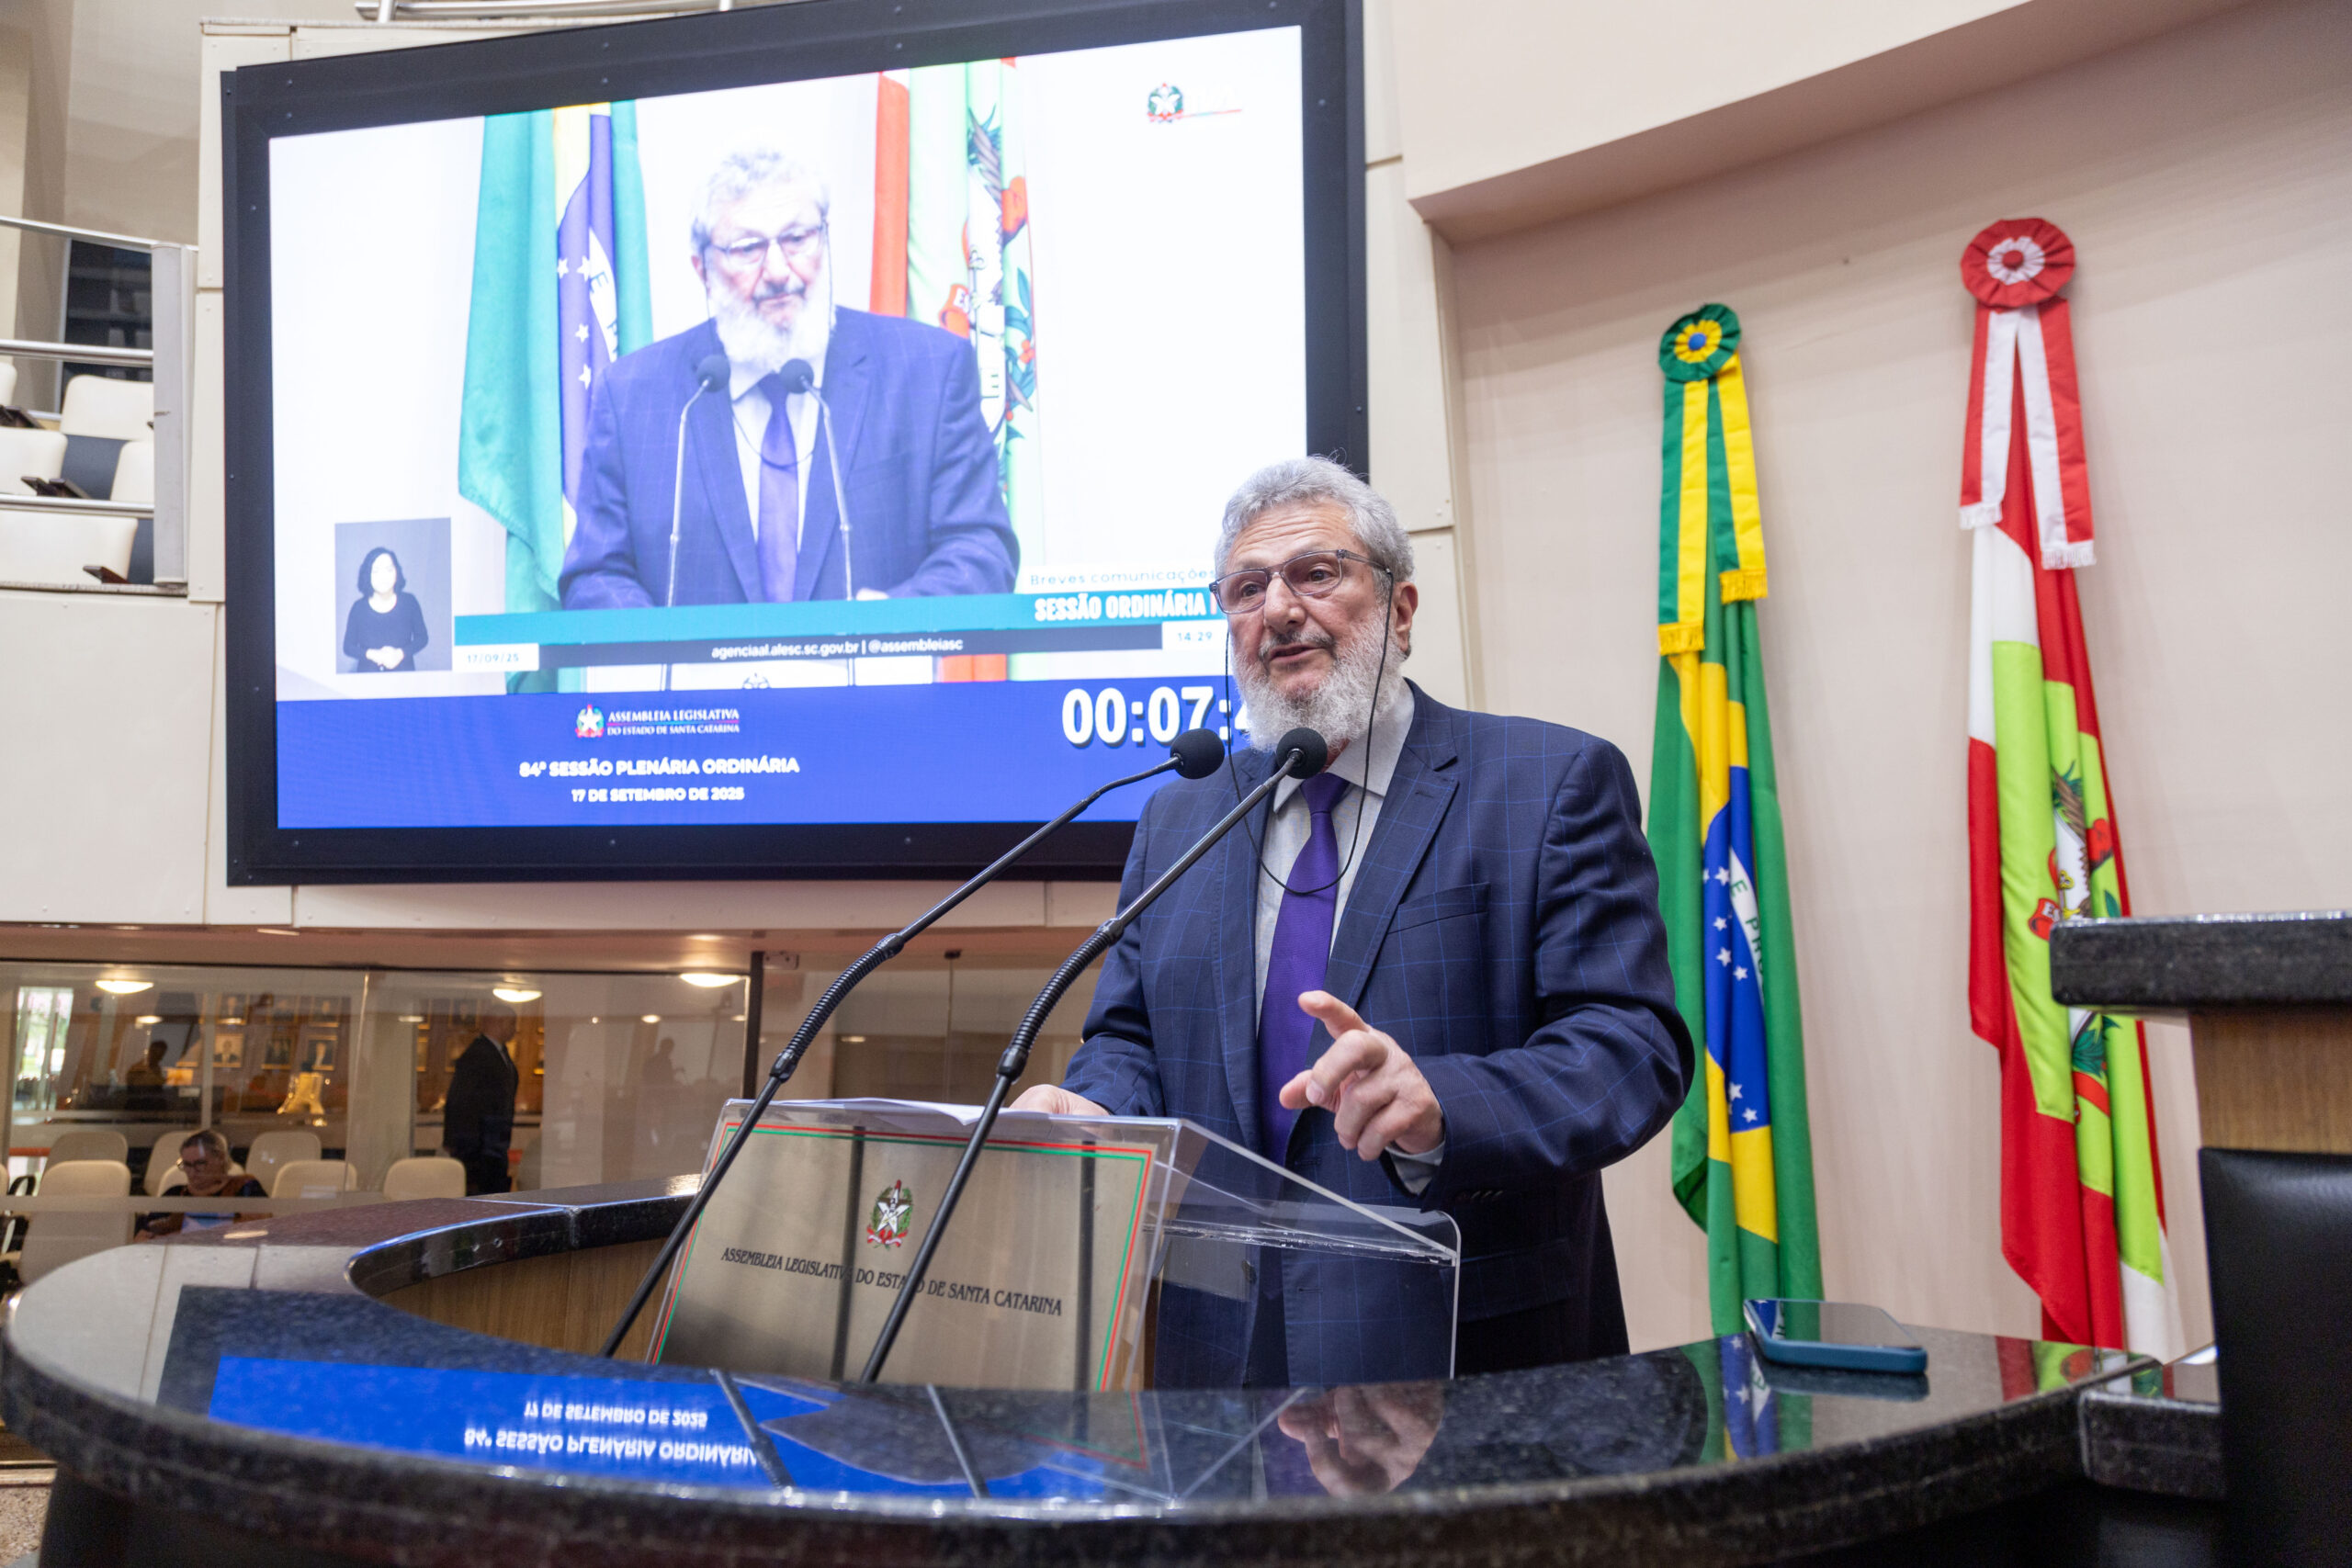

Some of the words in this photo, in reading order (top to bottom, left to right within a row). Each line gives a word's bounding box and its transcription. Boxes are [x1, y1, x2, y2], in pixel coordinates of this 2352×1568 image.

[1030, 574, 1085, 586] Breves
[1035, 592, 1102, 622] SESSÃO
[1105, 589, 1207, 619] ORDINÁRIA
[711, 641, 860, 660] agenciaal.alesc.sc.gov.br
[868, 638, 964, 654] @assembleiasc
[607, 710, 671, 723] ASSEMBLEIA
[673, 708, 740, 721] LEGISLATIVA
[606, 727, 621, 736] DO
[623, 725, 654, 735] ESTADO
[656, 724, 667, 735] DE
[670, 724, 695, 734] SANTA
[697, 723, 741, 734] CATARINA
[549, 758, 613, 776] SESSÃO
[616, 757, 700, 775] PLENÁRIA
[702, 755, 800, 773] ORDINÁRIA
[571, 789, 586, 802] 17
[588, 789, 608, 802] DE
[610, 788, 686, 802] SETEMBRO
[689, 787, 709, 800] DE
[711, 786, 745, 800] 2025
[721, 1247, 782, 1270] ASSEMBLEIA
[855, 1268, 875, 1285] DO
[876, 1271, 925, 1293] ESTAO
[927, 1280, 945, 1297] DE
[947, 1282, 990, 1305] SANTA
[993, 1290, 1062, 1316] CATARINA
